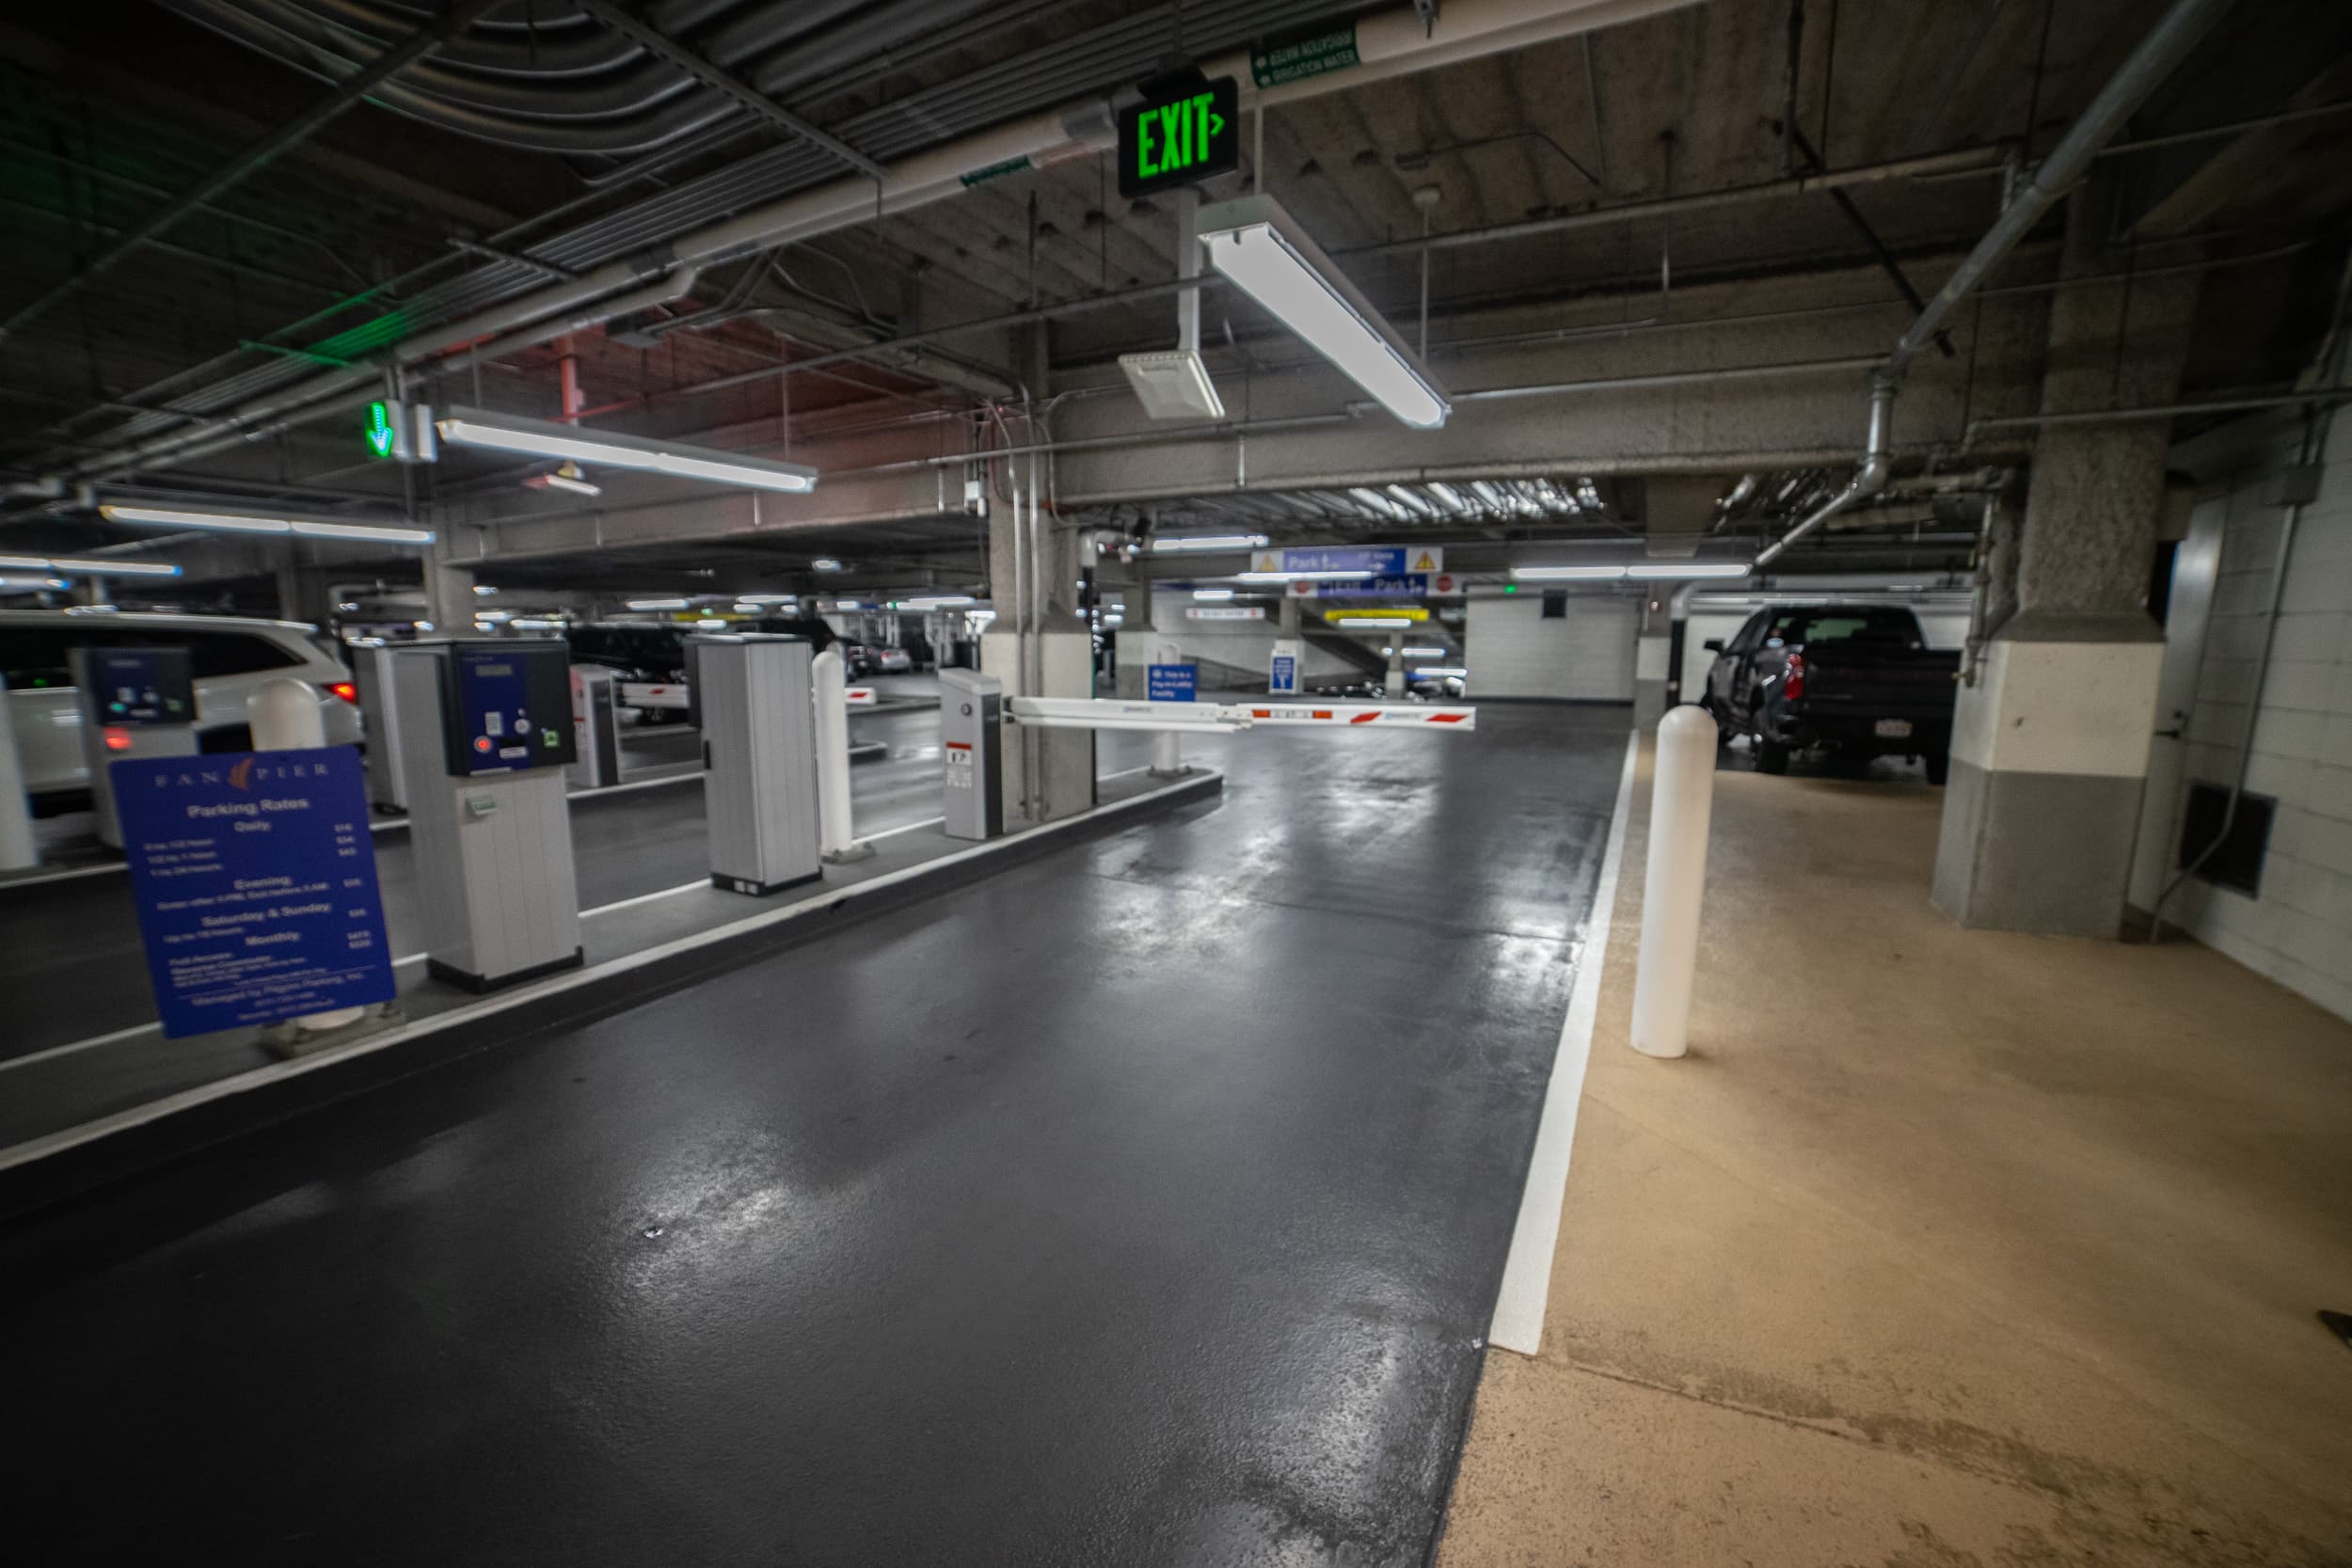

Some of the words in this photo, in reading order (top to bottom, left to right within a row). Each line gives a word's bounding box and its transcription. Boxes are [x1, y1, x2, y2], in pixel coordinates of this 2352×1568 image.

[1323, 49, 1355, 69] WATER
[1137, 91, 1216, 179] EXIT
[154, 770, 221, 788] FAN
[255, 762, 329, 782] PIER
[186, 800, 260, 819] Parking
[260, 796, 310, 813] Rates
[233, 876, 294, 890] Evening
[201, 910, 265, 927] Saturday
[267, 907, 279, 920] &
[281, 902, 332, 918] Sunday
[245, 930, 301, 947] Monthly
